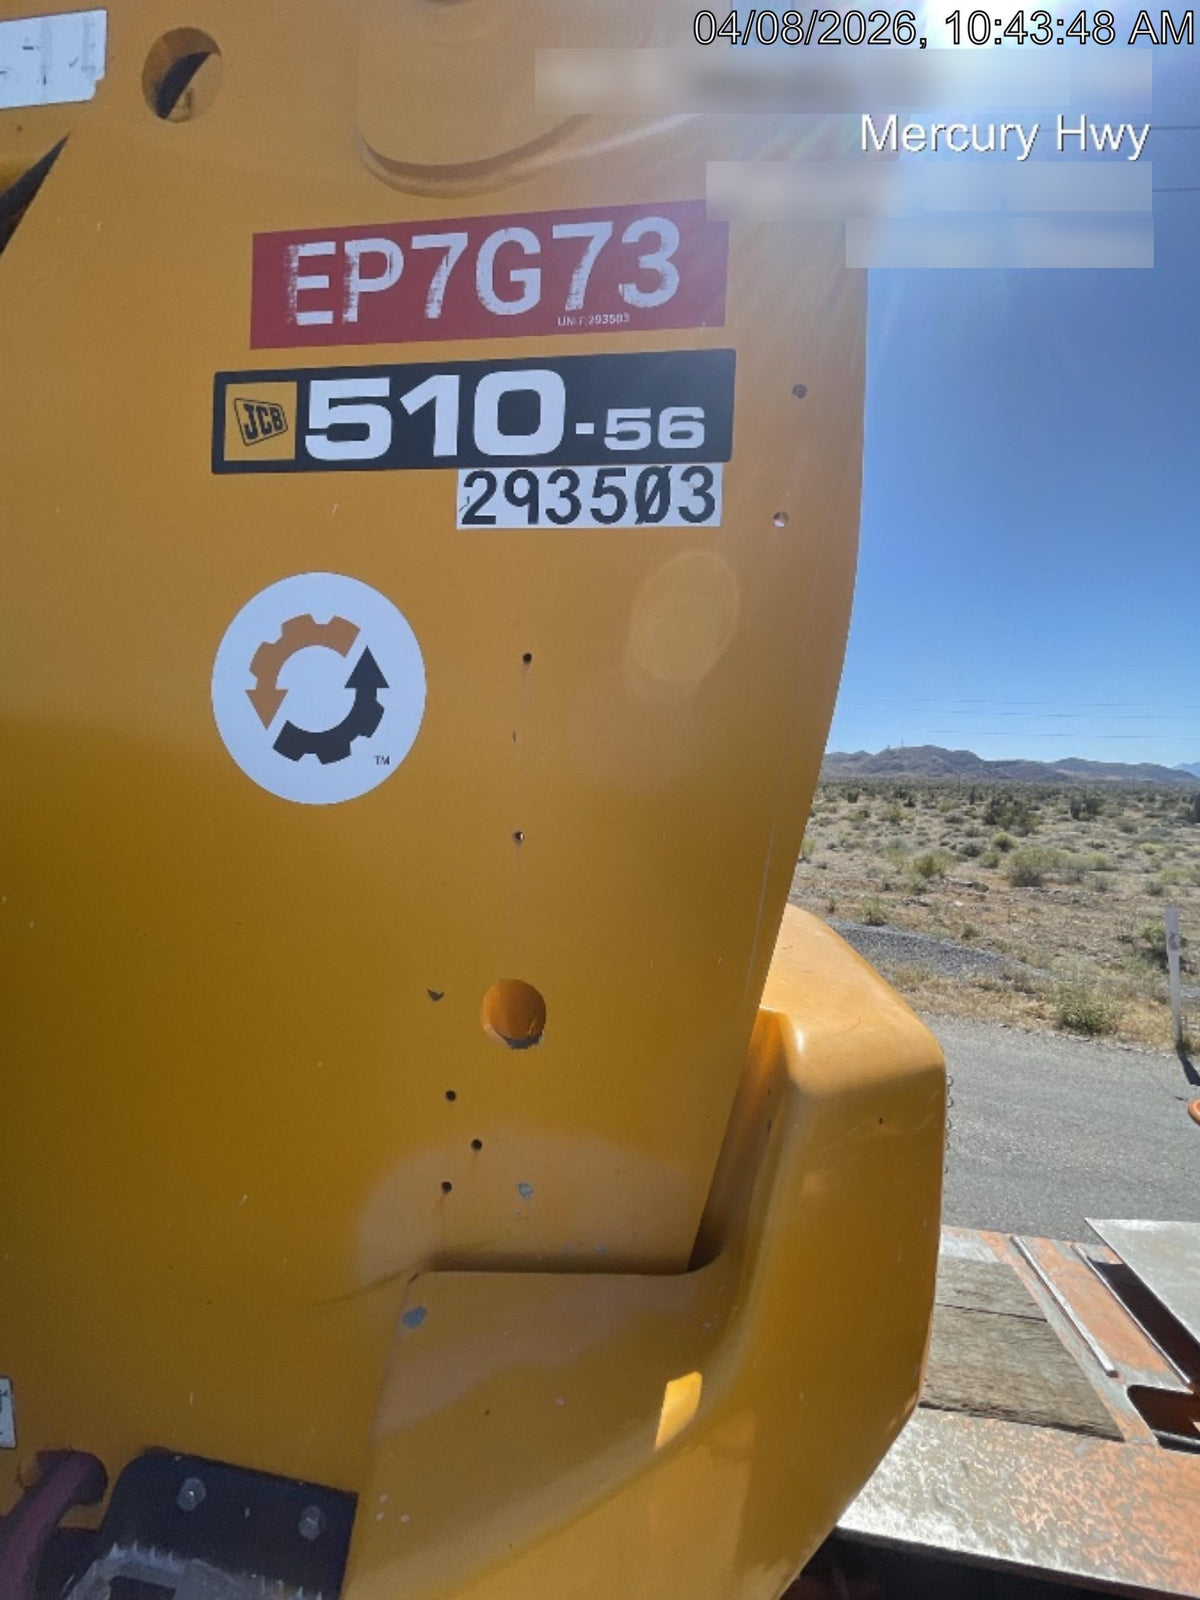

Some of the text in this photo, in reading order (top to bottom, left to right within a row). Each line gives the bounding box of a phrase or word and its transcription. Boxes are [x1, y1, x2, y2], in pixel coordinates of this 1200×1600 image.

[286, 216, 680, 325] EP7G73
[243, 403, 284, 439] JCB
[461, 465, 716, 526] 293503
[374, 755, 390, 765] TM
